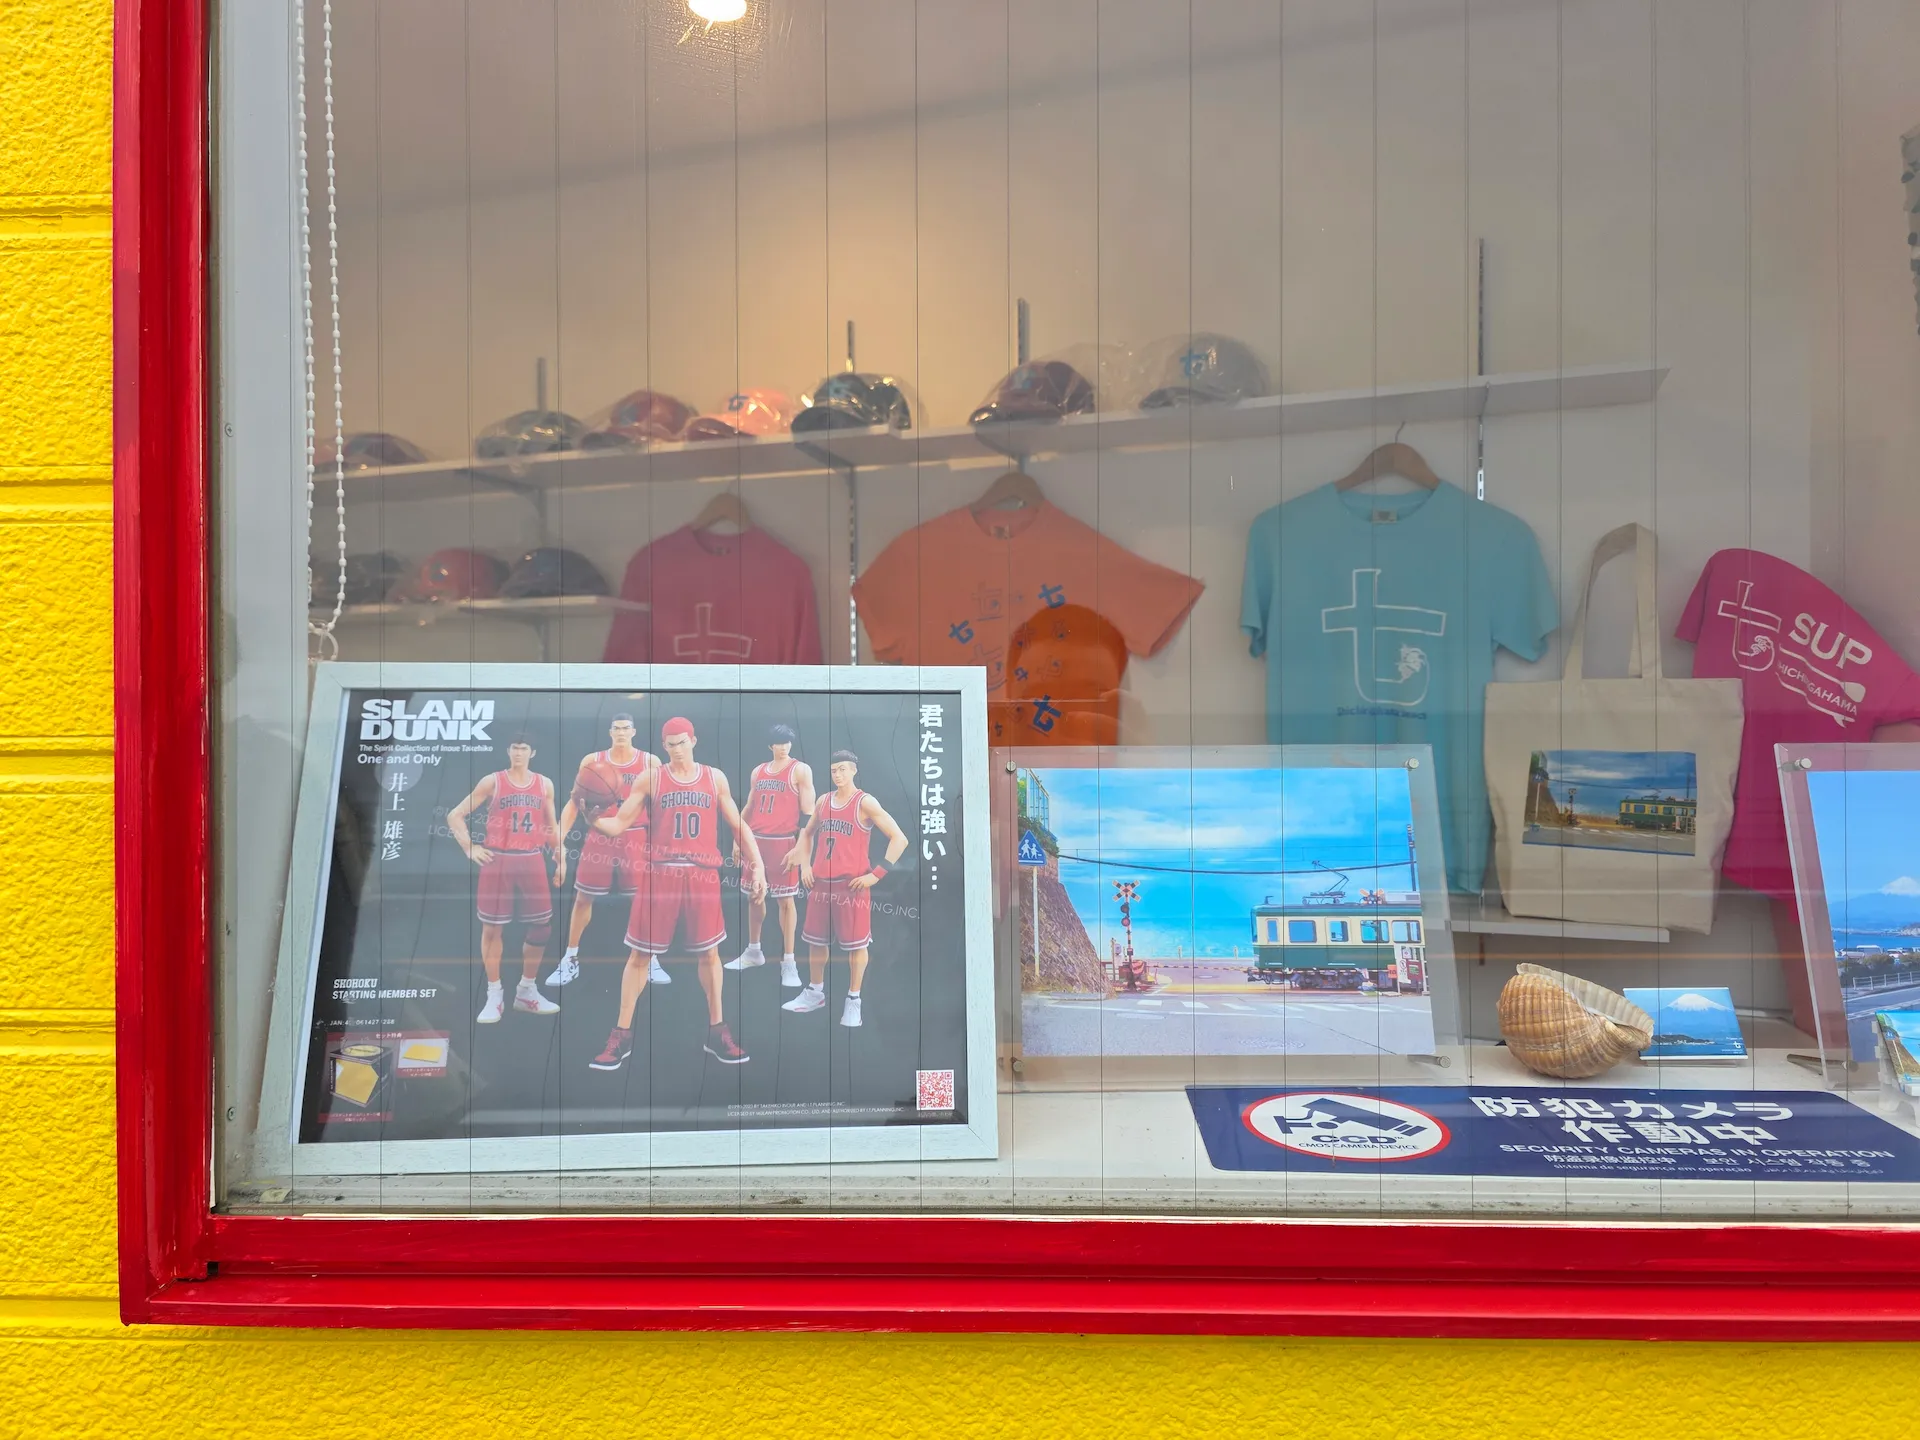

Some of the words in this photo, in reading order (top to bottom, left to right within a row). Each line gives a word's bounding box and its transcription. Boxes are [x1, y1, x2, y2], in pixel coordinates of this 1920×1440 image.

[1788, 613, 1873, 669] SUP
[361, 698, 495, 720] SLAM
[360, 720, 492, 740] DUNK
[359, 744, 372, 752] The
[373, 744, 394, 753] Spirit
[395, 744, 430, 752] Collection
[431, 744, 440, 752] of
[440, 744, 460, 752] Inoue
[357, 753, 383, 764] One
[386, 753, 410, 764] and
[413, 753, 442, 767] Only
[661, 791, 712, 809] SHOHOKU
[760, 793, 775, 814] 11
[512, 811, 534, 834] 14
[673, 811, 701, 839] 10
[586, 832, 622, 848] INOUE
[624, 841, 654, 855] AND
[826, 837, 836, 860] 7
[690, 871, 718, 884] AND
[797, 888, 813, 900] BY
[332, 990, 377, 999] STARTING
[378, 989, 418, 999] MEMBER
[419, 988, 437, 998] SET
[333, 978, 378, 989] SHOHOKU
[1468, 1096, 1794, 1121] 防犯カメラ
[1311, 1135, 1397, 1144] CCD
[1561, 1120, 1779, 1146] 作動中
[1499, 1144, 1608, 1154] SECURITY
[1617, 1146, 1727, 1156] CAMERAS
[1730, 1148, 1758, 1157] IN
[1761, 1149, 1895, 1159] OPERATION
